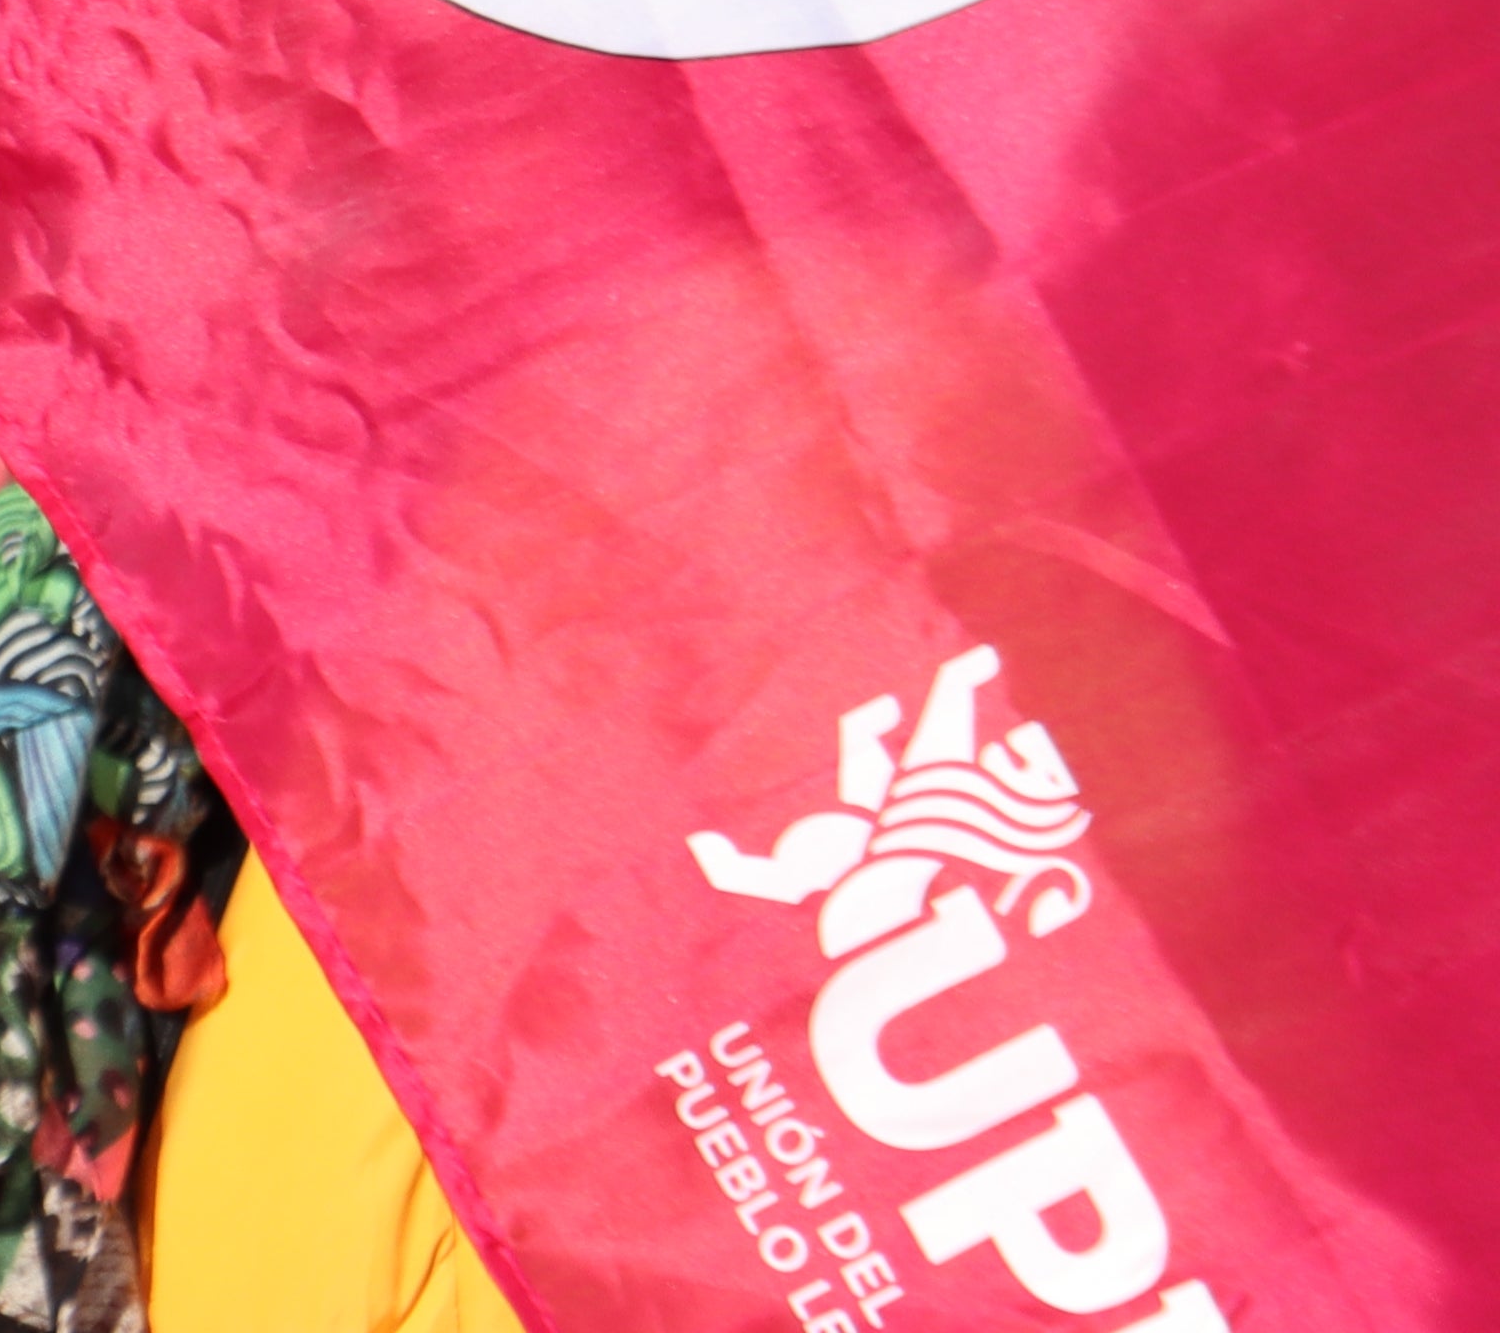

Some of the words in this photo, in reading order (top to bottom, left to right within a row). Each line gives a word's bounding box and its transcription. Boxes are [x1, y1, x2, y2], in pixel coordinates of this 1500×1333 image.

[654, 1050, 809, 1273] PUEBLO
[709, 1021, 844, 1209] UNIÓN
[817, 1211, 905, 1330] DEL
